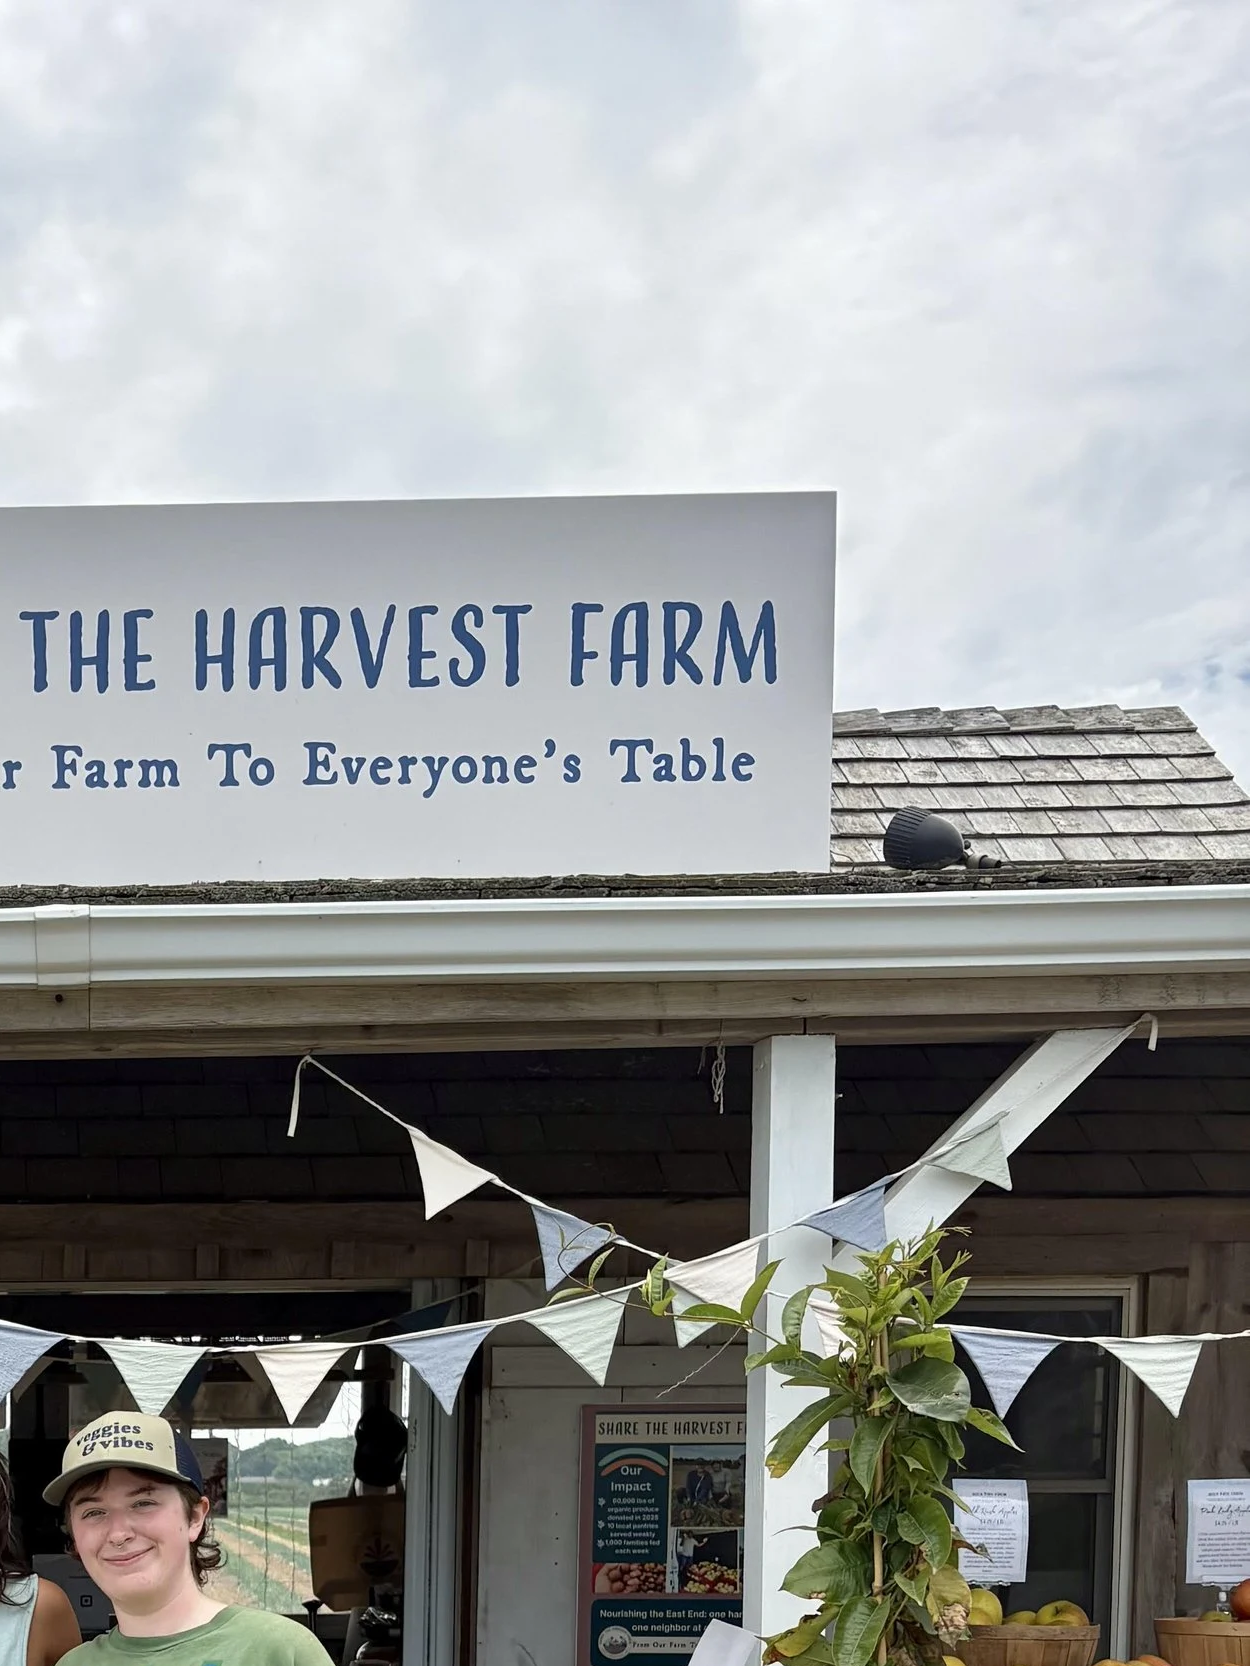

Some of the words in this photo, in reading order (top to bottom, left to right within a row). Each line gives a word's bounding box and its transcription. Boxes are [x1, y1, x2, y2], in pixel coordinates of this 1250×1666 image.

[19, 608, 156, 694] THE
[194, 603, 533, 692] HARVEST
[570, 600, 778, 686] FARM
[50, 744, 180, 789] Farm
[207, 742, 276, 787] To
[302, 738, 581, 798] Everyone's
[609, 737, 756, 783] Table
[76, 1422, 142, 1447] veggies
[598, 1421, 639, 1436] SHARE
[645, 1421, 669, 1435] THE
[674, 1421, 732, 1435] HARVEST
[99, 1436, 154, 1451] vibes
[620, 1465, 642, 1476] Our
[610, 1482, 652, 1493] Impact
[599, 1609, 648, 1619] Nourishing
[649, 1609, 664, 1618] the
[666, 1609, 686, 1618] East
[631, 1624, 649, 1632] one
[651, 1623, 690, 1634] neighbor
